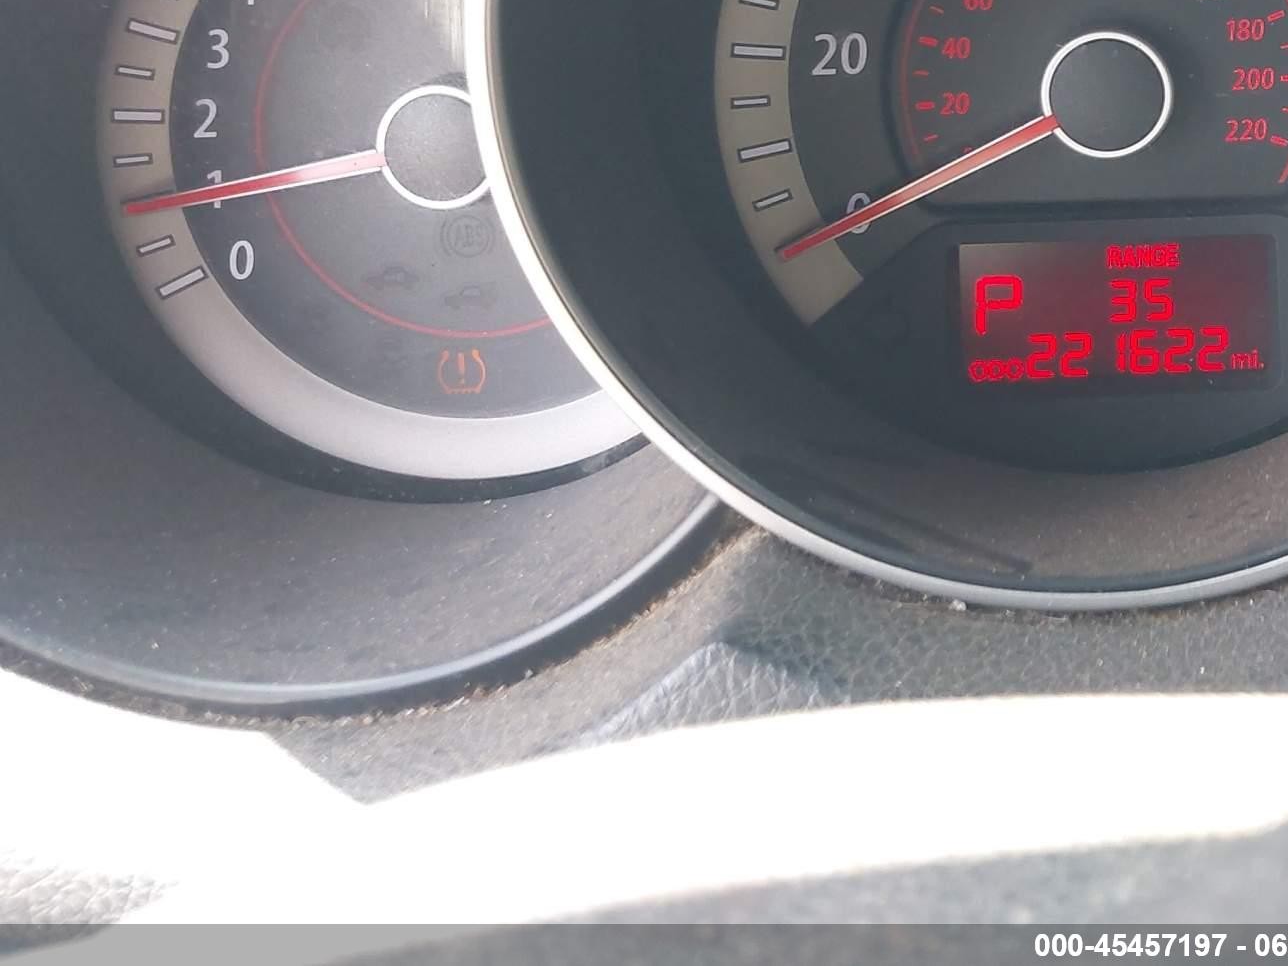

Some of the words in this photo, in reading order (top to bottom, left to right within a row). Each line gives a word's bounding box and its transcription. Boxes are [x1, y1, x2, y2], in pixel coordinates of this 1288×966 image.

[207, 28, 230, 69] 3
[942, 37, 971, 60] 40
[1226, 18, 1265, 42] 180
[811, 34, 868, 76] 20
[1232, 67, 1274, 90] 200
[194, 98, 218, 138] 2
[940, 92, 971, 116] 20
[1225, 119, 1267, 142] 220
[207, 169, 222, 208] 1
[846, 192, 871, 234] 0
[229, 240, 255, 280] 0
[1106, 243, 1181, 268] RANGE
[974, 274, 1024, 335] P
[1109, 277, 1175, 322] 35
[1230, 351, 1264, 370] mi.
